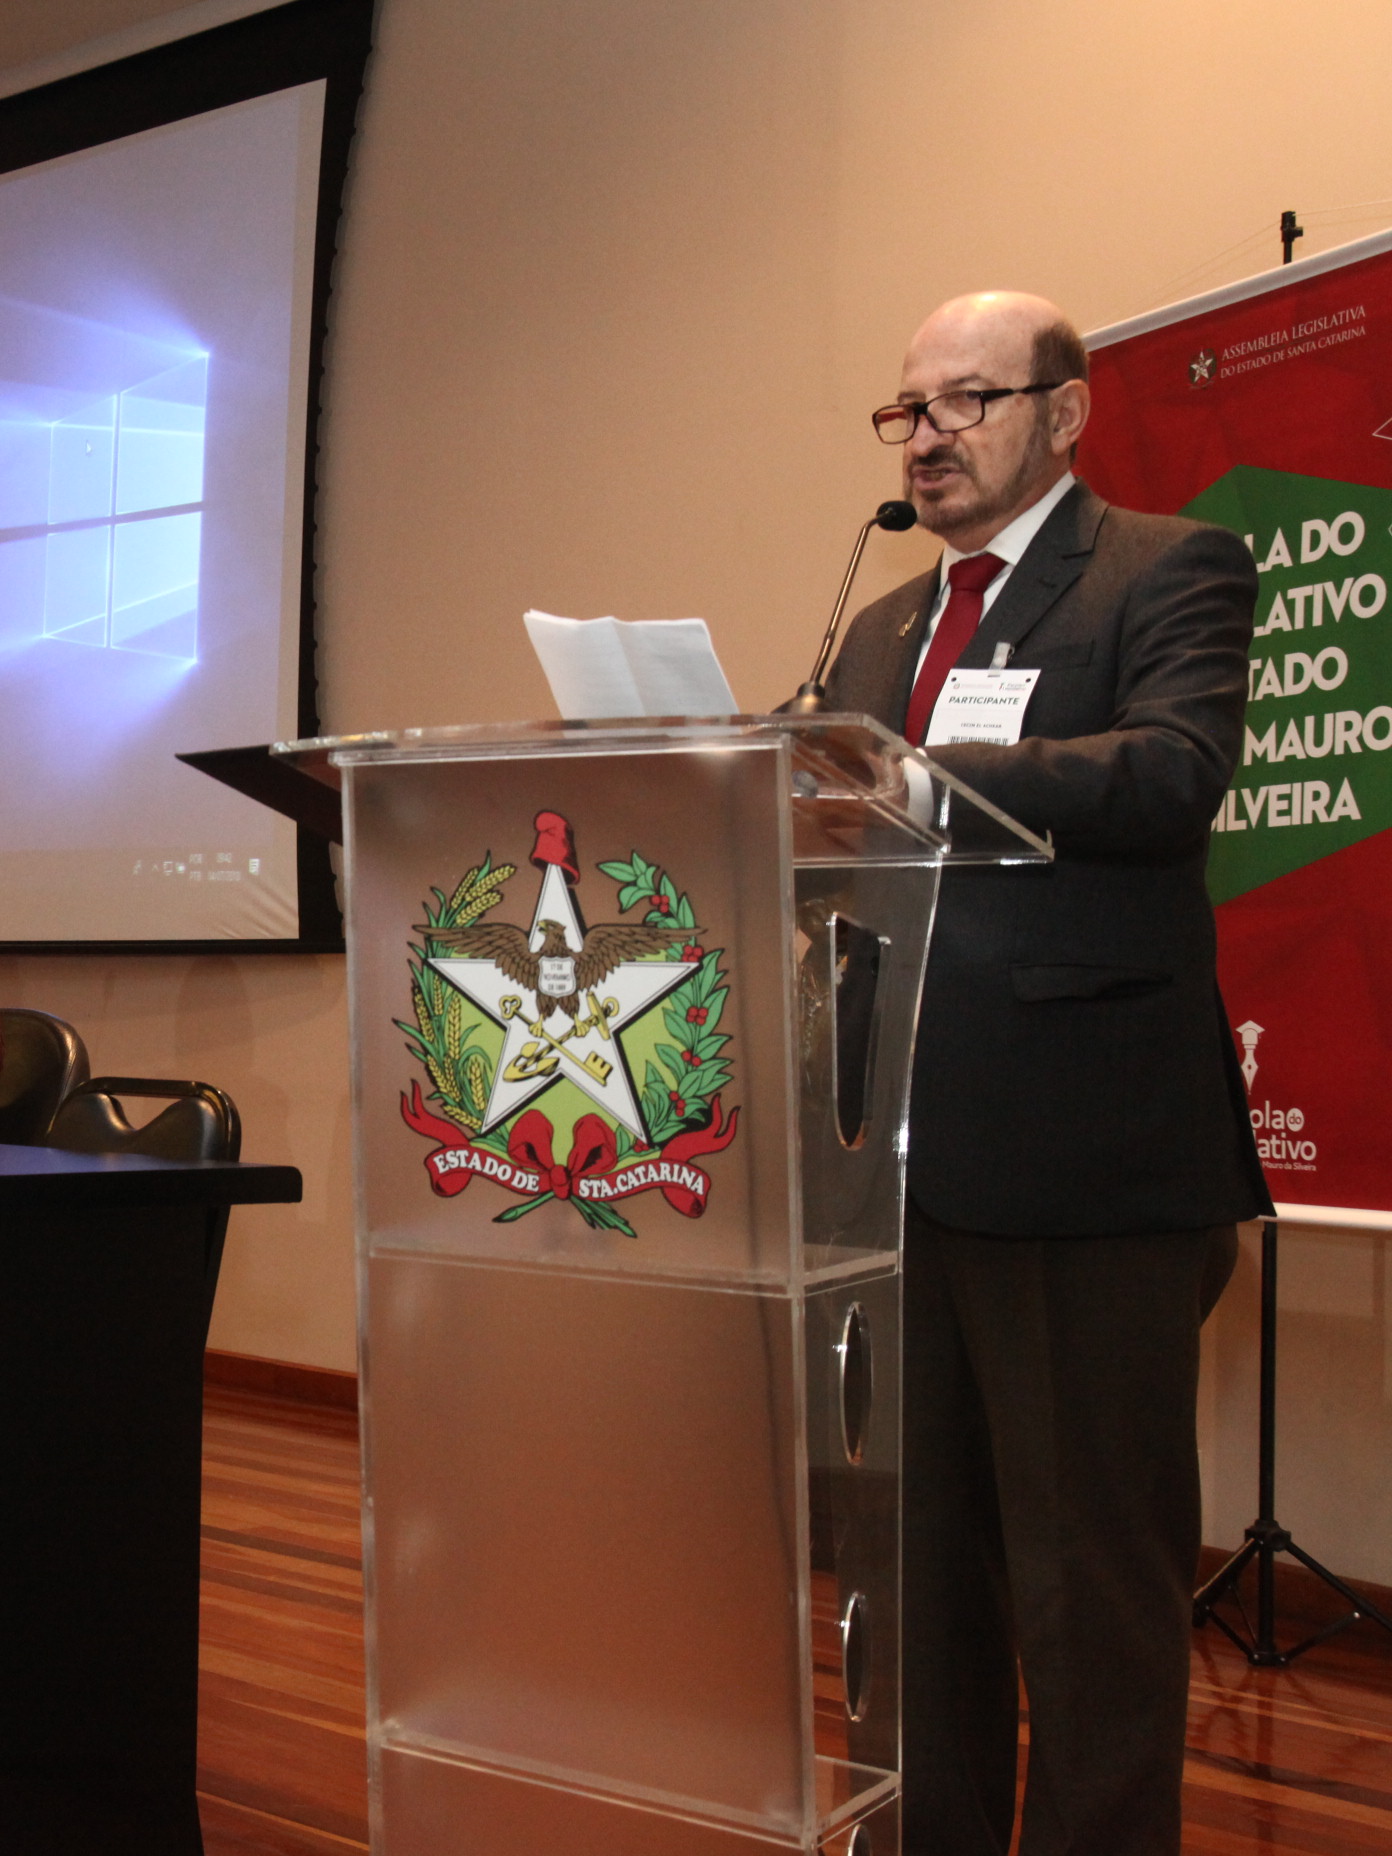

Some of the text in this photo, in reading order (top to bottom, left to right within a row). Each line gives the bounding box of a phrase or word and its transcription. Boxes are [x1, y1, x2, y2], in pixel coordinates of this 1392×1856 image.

[1220, 326, 1366, 378] DO ESTADO DE SANTA CATARINA
[1221, 305, 1366, 361] ASSEMBLEIA LEGISLATIVA
[1300, 511, 1365, 564] DO
[949, 696, 1020, 705] PARTICIPANTE
[1243, 705, 1392, 766] MAURO
[1211, 776, 1363, 833] ILVEIRA
[1289, 1113, 1302, 1125] do
[433, 1150, 511, 1181] ESTADO
[512, 1170, 539, 1192] DE
